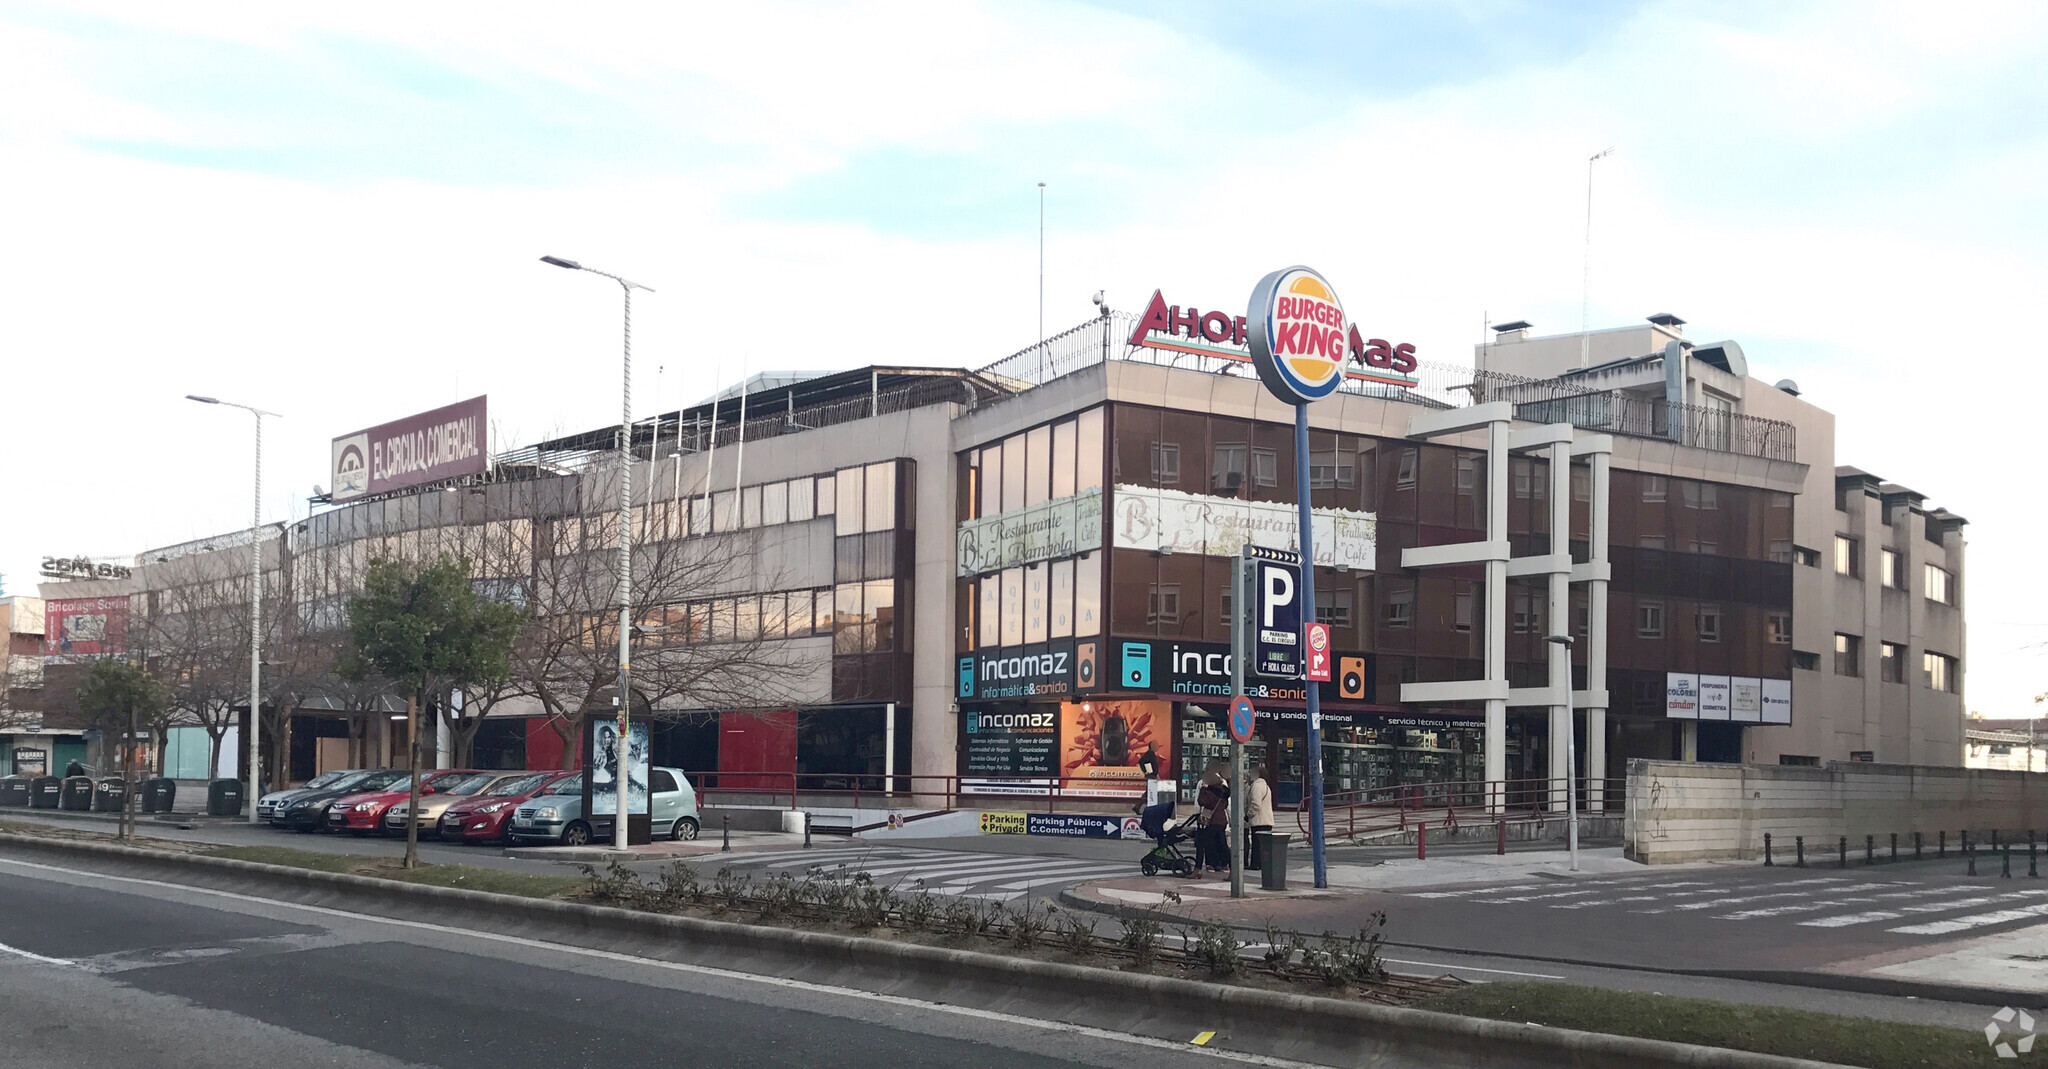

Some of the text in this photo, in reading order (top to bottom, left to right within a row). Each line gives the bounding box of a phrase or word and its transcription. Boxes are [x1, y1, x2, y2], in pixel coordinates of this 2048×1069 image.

[1277, 296, 1343, 331] BURGER
[1275, 322, 1344, 362] KING
[373, 415, 478, 480] EL CIRCULO COMERCIAL
[990, 512, 1062, 543] Restaurante
[980, 548, 1002, 571] La
[1264, 566, 1294, 627] P
[1269, 652, 1284, 661] LIBRE
[982, 652, 1068, 681] incomaz
[1268, 662, 1280, 672] HORA
[1667, 689, 1697, 697] COLORES
[979, 712, 1054, 728] incomaz
[1273, 712, 1279, 720] y
[1280, 711, 1307, 720] sonido
[1388, 718, 1416, 726] servicio
[1418, 718, 1443, 727] técnico
[989, 814, 1025, 826] Parking
[1030, 817, 1102, 827] Parking Público
[989, 824, 1024, 833] Privado
[1030, 826, 1086, 835] C.Comercial
